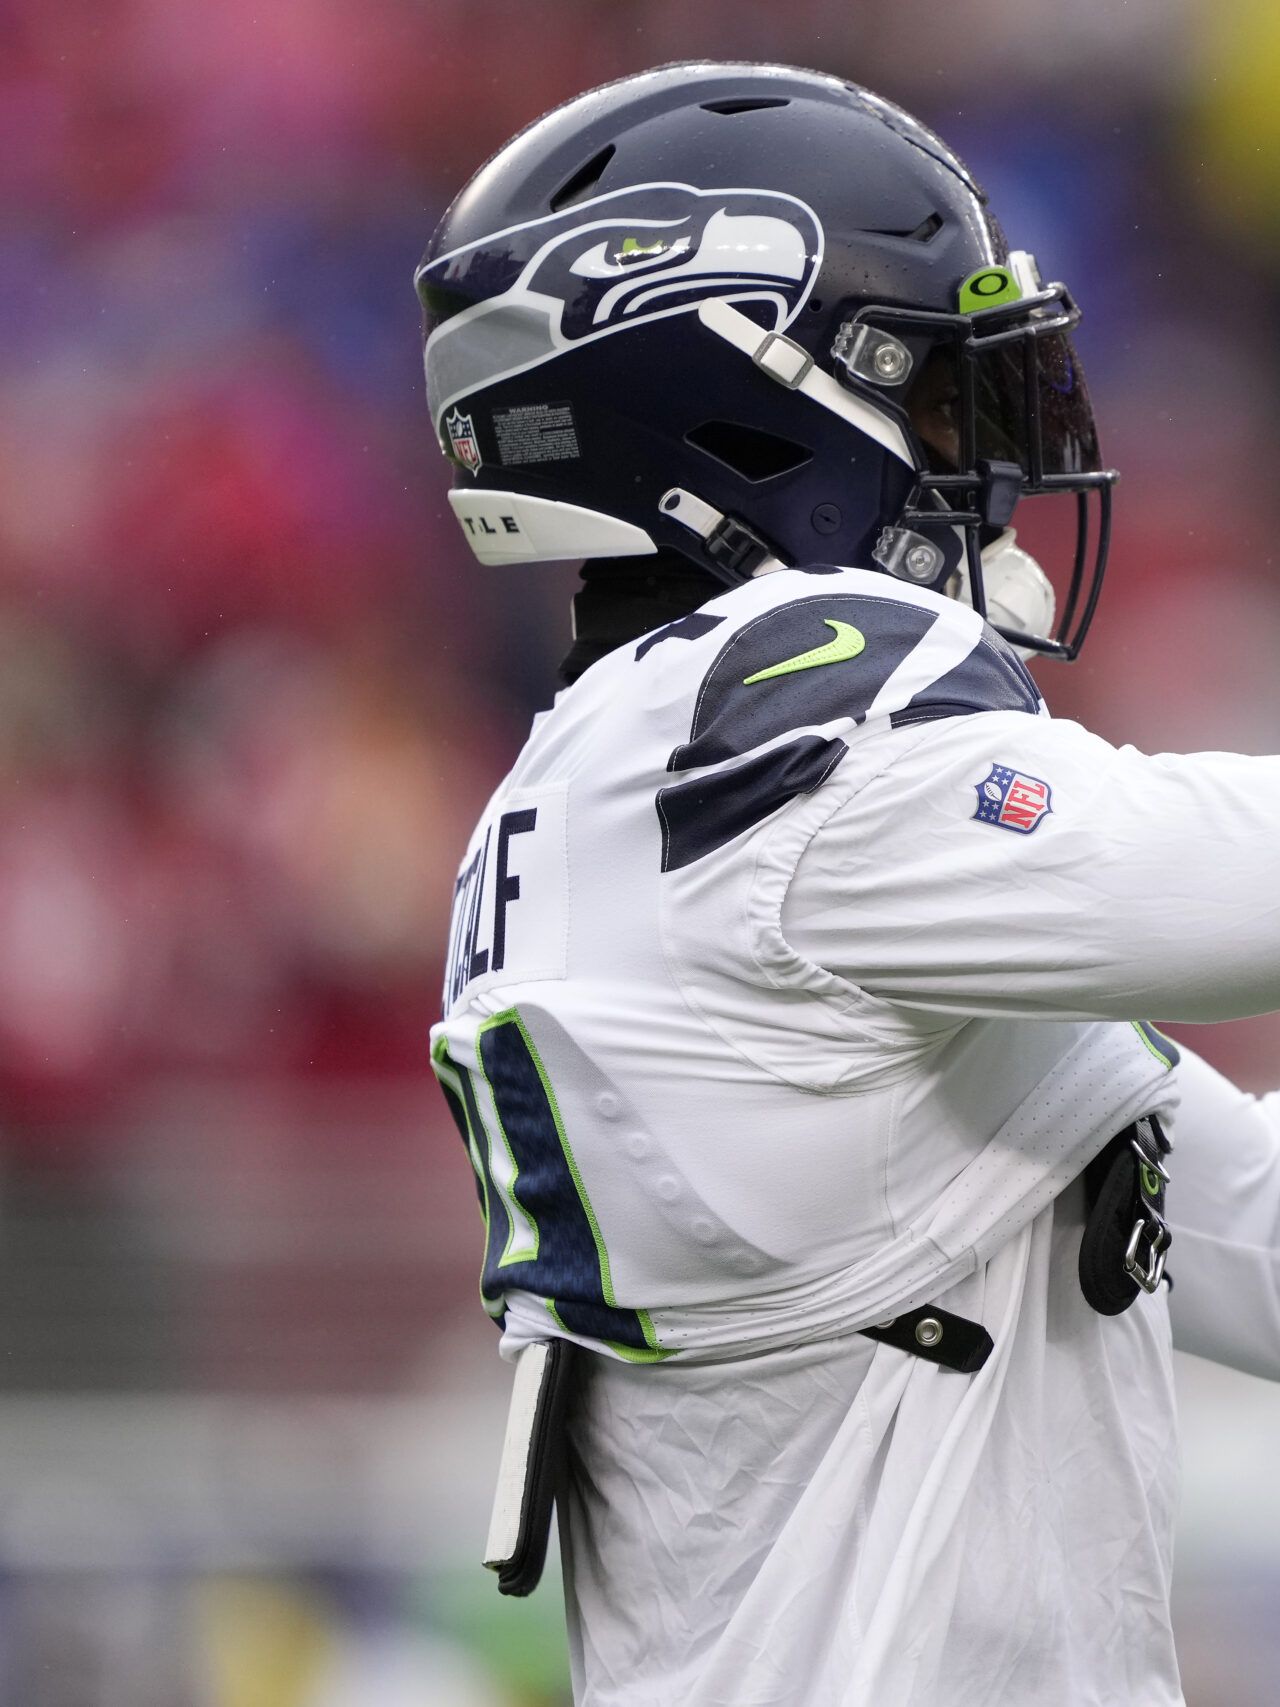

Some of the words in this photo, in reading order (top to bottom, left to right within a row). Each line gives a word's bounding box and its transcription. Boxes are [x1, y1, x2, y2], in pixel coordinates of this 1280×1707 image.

[508, 404, 549, 414] WARNING
[454, 437, 478, 465] NFL
[1001, 777, 1046, 829] NFL
